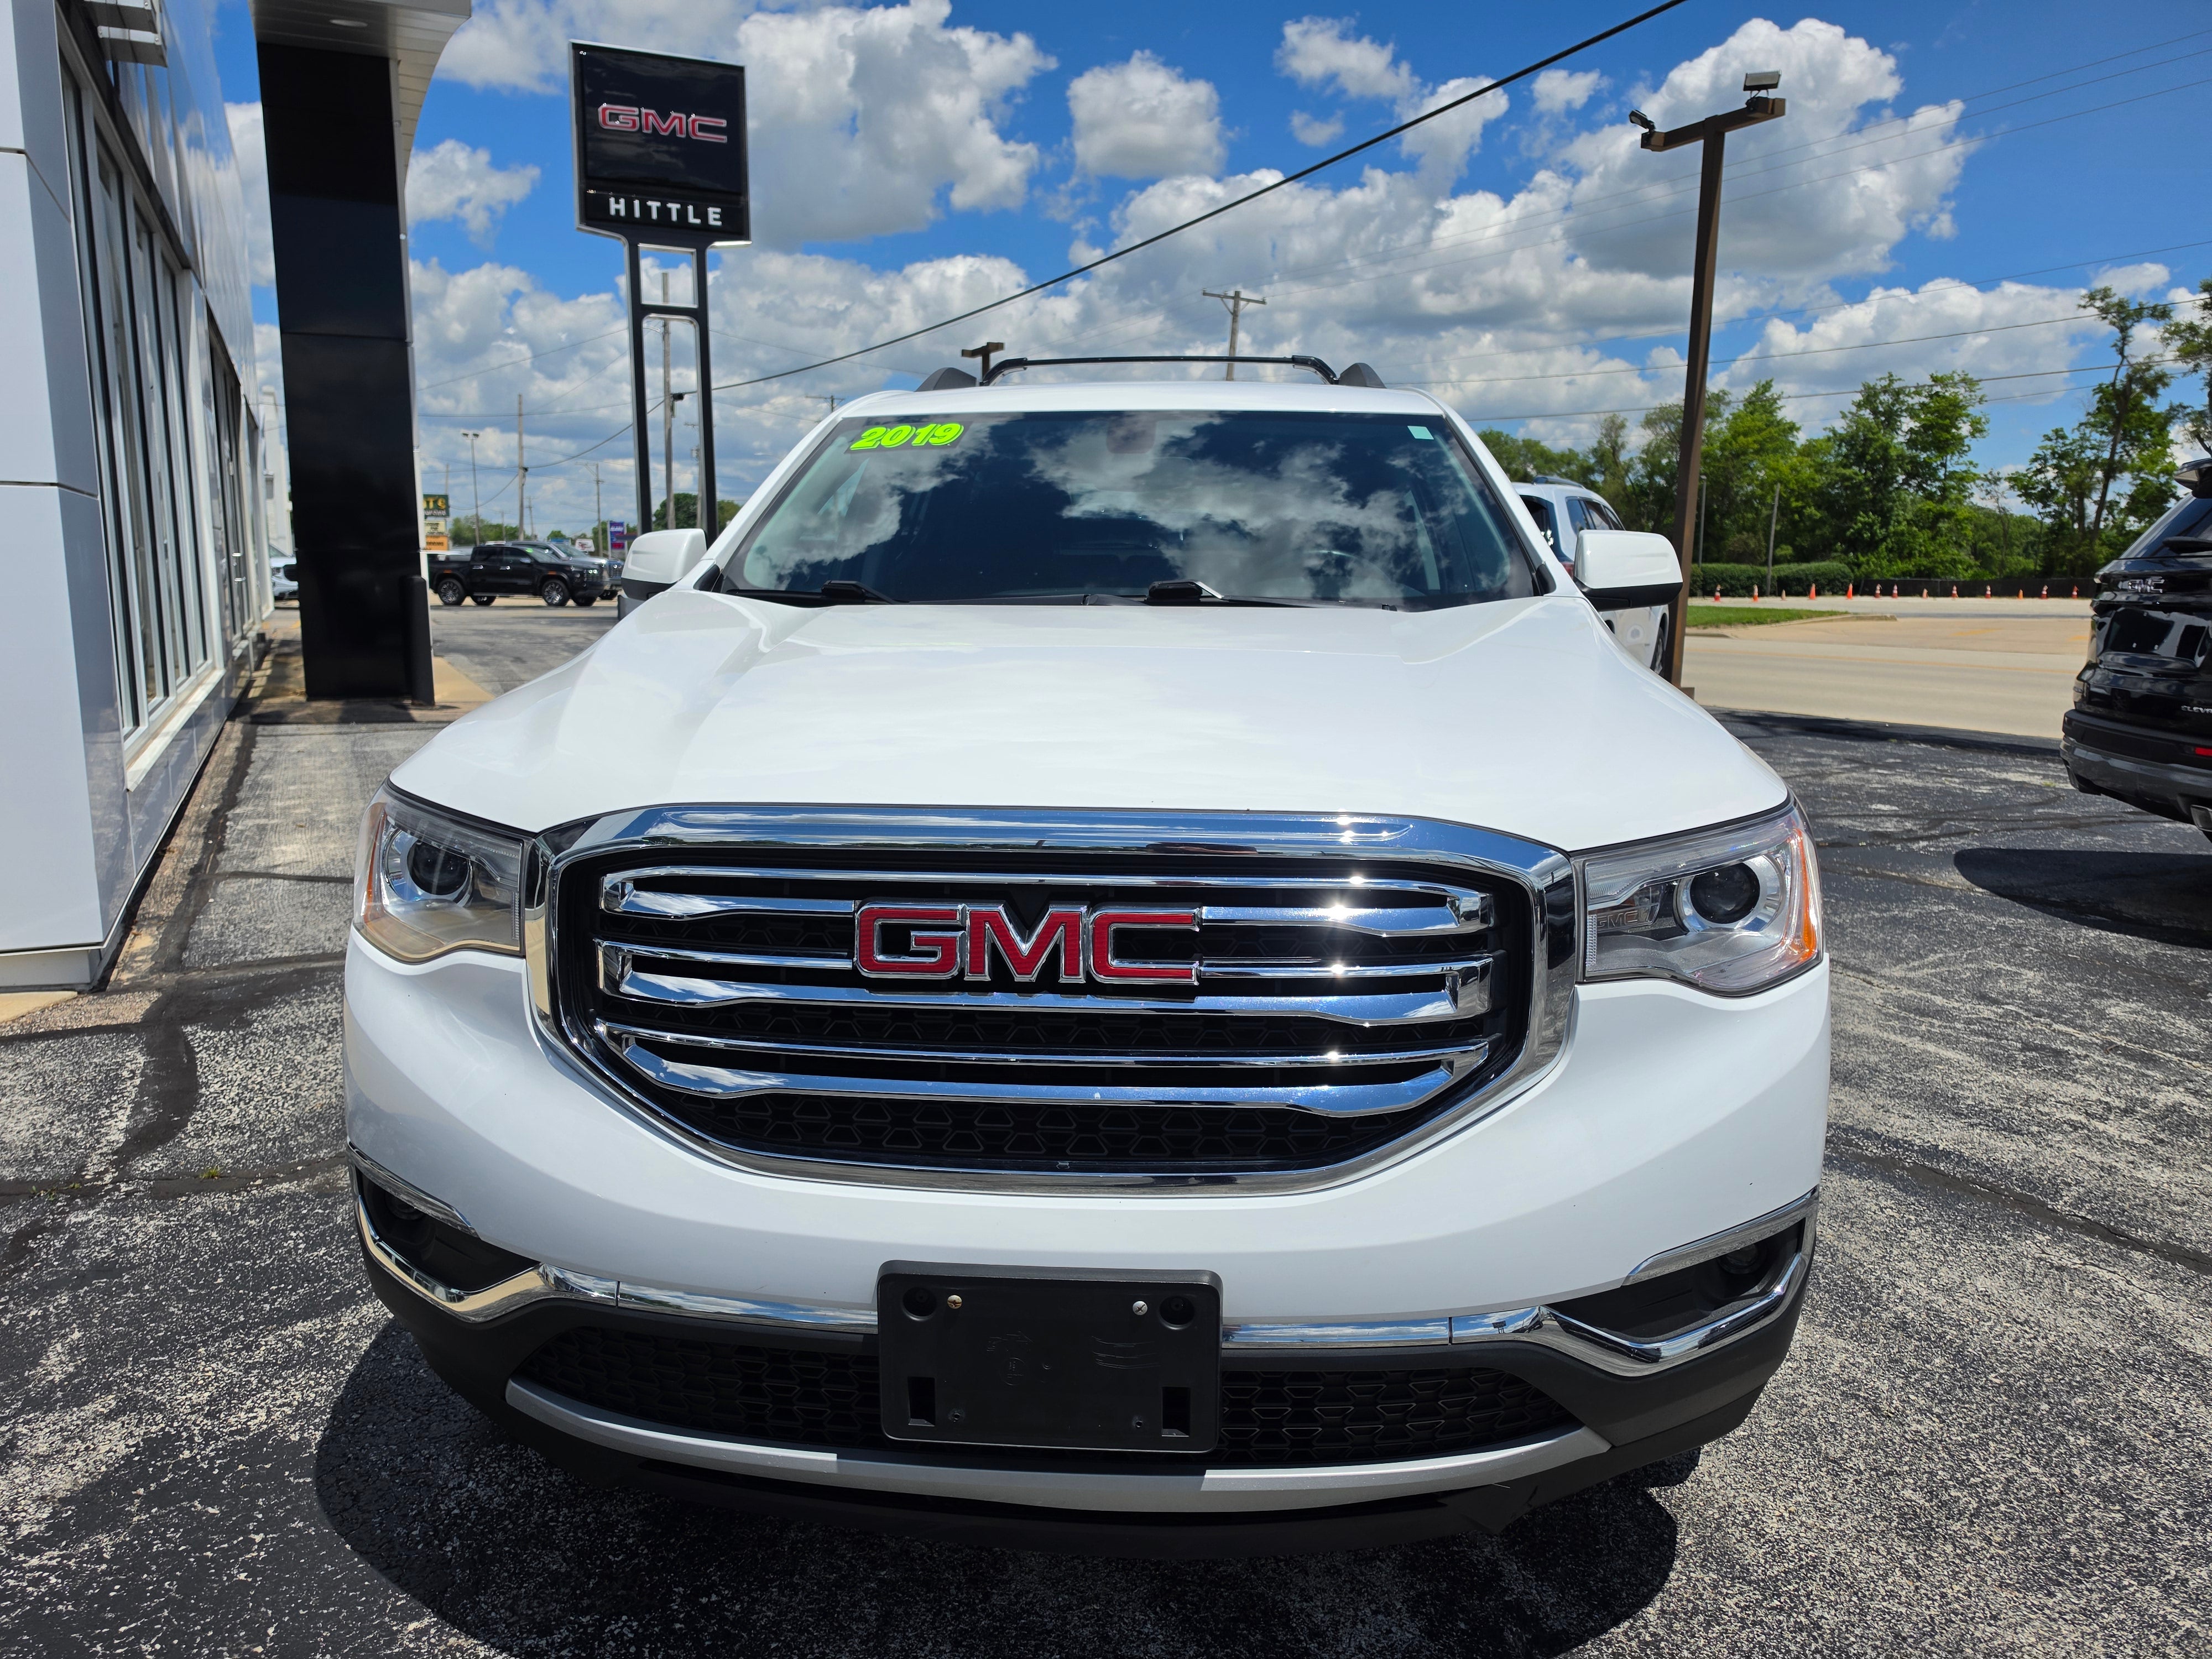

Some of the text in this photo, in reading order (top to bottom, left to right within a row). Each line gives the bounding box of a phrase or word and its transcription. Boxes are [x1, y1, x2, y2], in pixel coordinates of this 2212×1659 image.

[598, 104, 727, 143] GMC
[609, 197, 722, 226] HITTLE
[850, 422, 964, 450] 2019
[854, 899, 1202, 985] GMC
